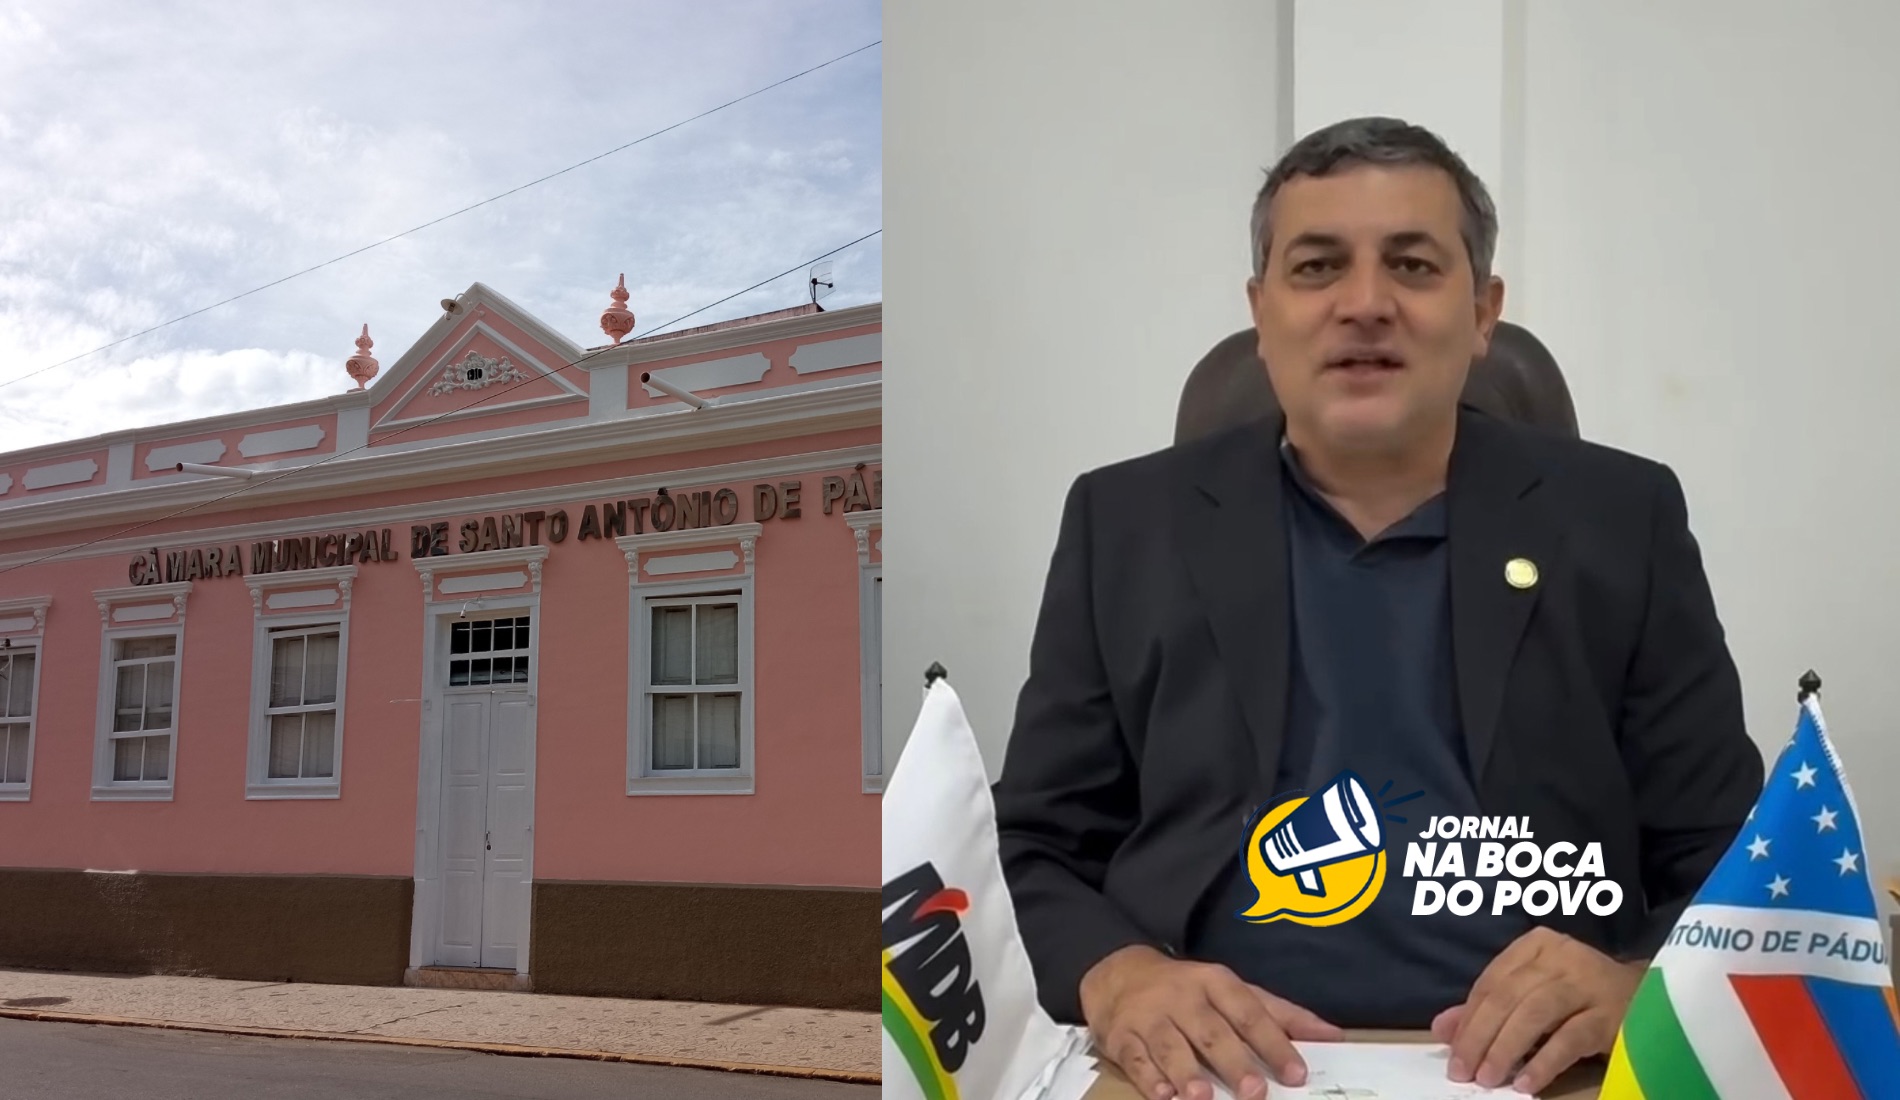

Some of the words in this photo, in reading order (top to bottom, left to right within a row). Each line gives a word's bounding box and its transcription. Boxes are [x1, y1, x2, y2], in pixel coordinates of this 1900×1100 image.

[251, 528, 398, 575] MUNICIPAL
[411, 521, 449, 559] DE
[459, 508, 569, 553] SANTO
[577, 487, 739, 541] ANTÔNIO
[753, 480, 801, 523] DE
[882, 861, 986, 1074] MDB
[1761, 930, 1802, 953] DE
[1807, 931, 1888, 966] PÁDU
